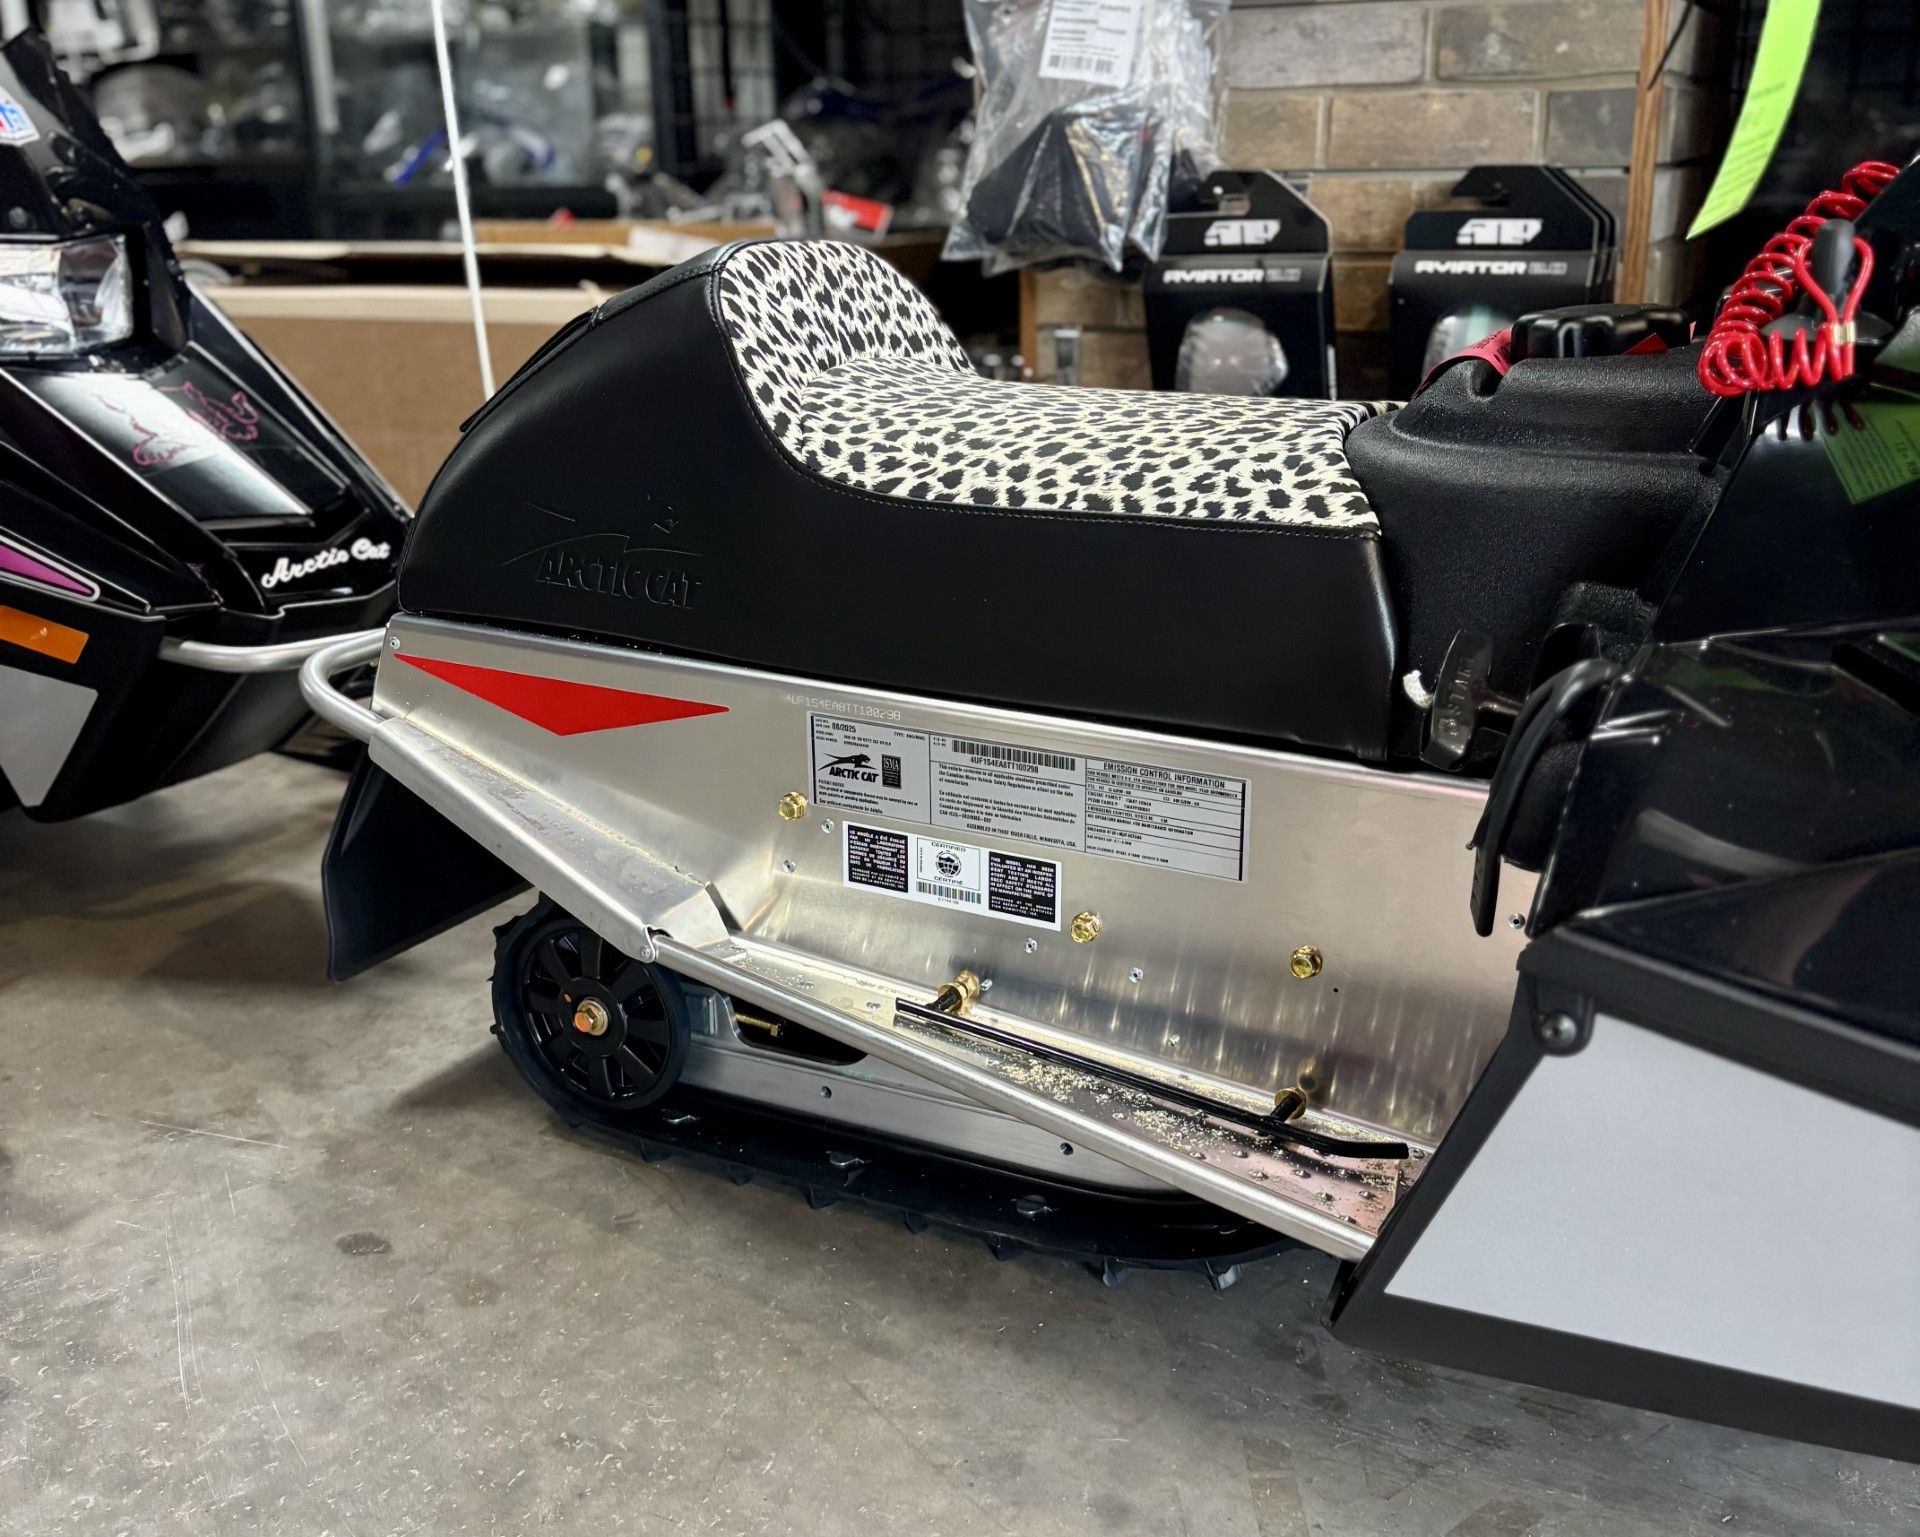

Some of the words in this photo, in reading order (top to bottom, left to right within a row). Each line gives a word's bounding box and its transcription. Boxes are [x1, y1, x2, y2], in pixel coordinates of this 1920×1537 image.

[1415, 260, 1527, 274] AVIATOR
[1163, 268, 1264, 284] AVIATOR
[261, 547, 350, 588] Arctic
[350, 537, 391, 560] Cat
[536, 551, 634, 599] ARCTIC
[645, 569, 702, 610] CAT
[832, 723, 856, 733] 08/2025
[829, 766, 859, 780] ARCTIC
[861, 771, 879, 783] CAT
[1104, 763, 1137, 775] EMISSION
[1140, 769, 1172, 780] CONTROL
[1175, 774, 1225, 789] INFORMATION
[932, 842, 965, 852] CERTIFIED
